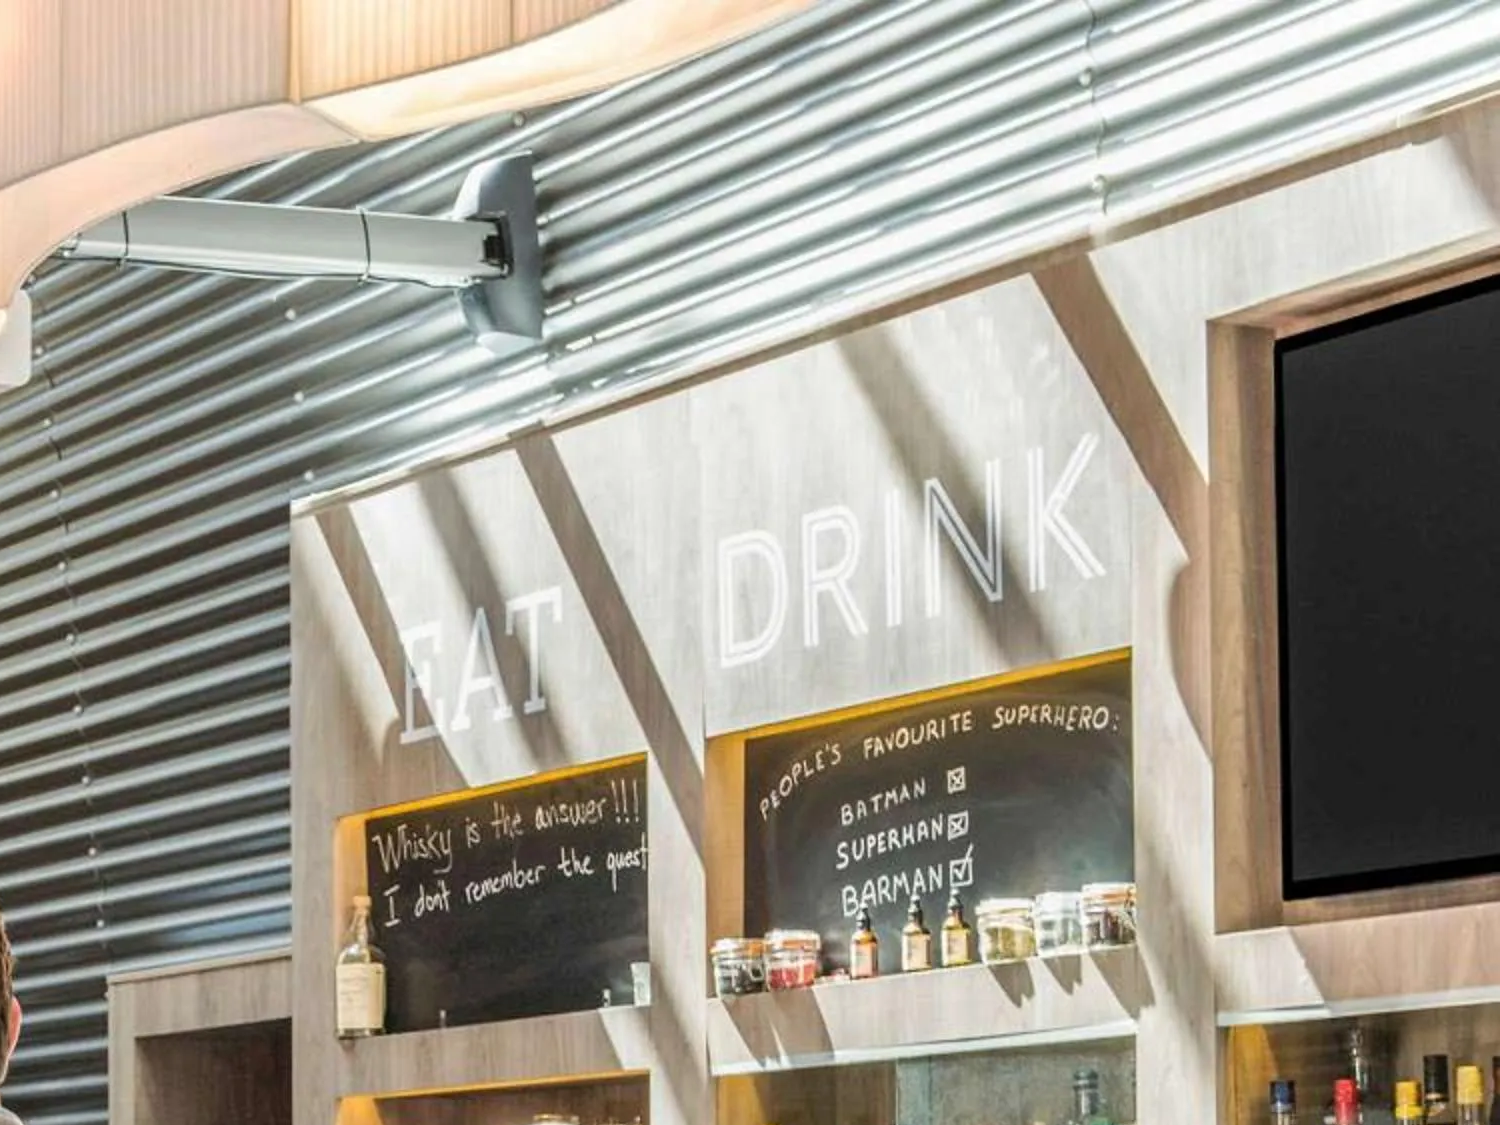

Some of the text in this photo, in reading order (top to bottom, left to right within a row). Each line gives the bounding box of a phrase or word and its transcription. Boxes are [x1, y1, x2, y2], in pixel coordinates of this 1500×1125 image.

[717, 432, 1107, 668] DRINK
[400, 585, 563, 745] EAT
[759, 703, 1121, 820] PEOPLE'S FAVOURITE SUPERHERO:
[841, 776, 927, 826] BATMAN
[372, 822, 453, 874] Whisky
[465, 816, 481, 848] is
[491, 799, 526, 840] the
[384, 884, 401, 928] I
[465, 857, 546, 905] remember
[557, 846, 594, 878] the
[842, 863, 944, 918] BARMAN
